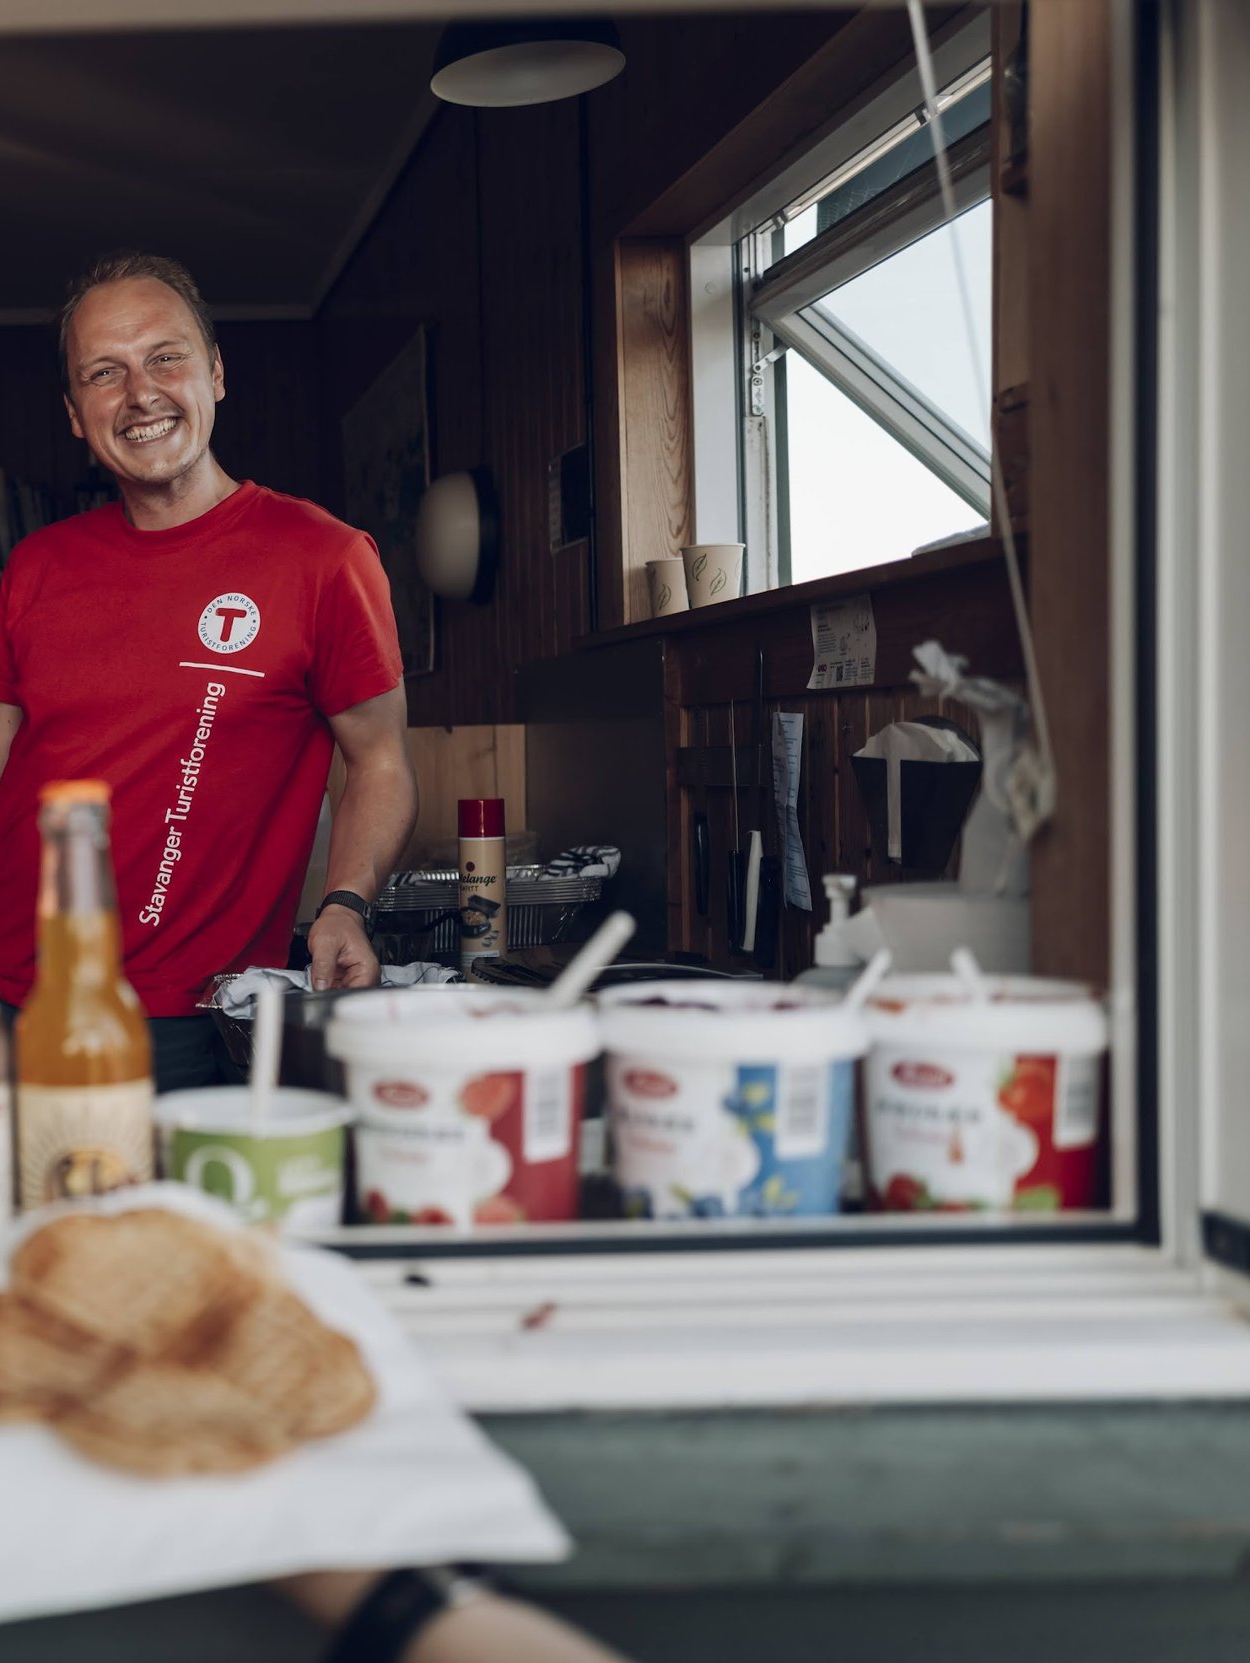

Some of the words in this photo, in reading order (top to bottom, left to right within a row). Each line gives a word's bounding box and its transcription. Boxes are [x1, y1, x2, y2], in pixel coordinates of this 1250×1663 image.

[206, 598, 224, 614] DEN
[227, 595, 257, 616] NORSKE
[199, 621, 257, 652] TURISTFORENING
[215, 607, 248, 643] T
[138, 826, 184, 927] Stavanger
[164, 682, 227, 825] Turistforening
